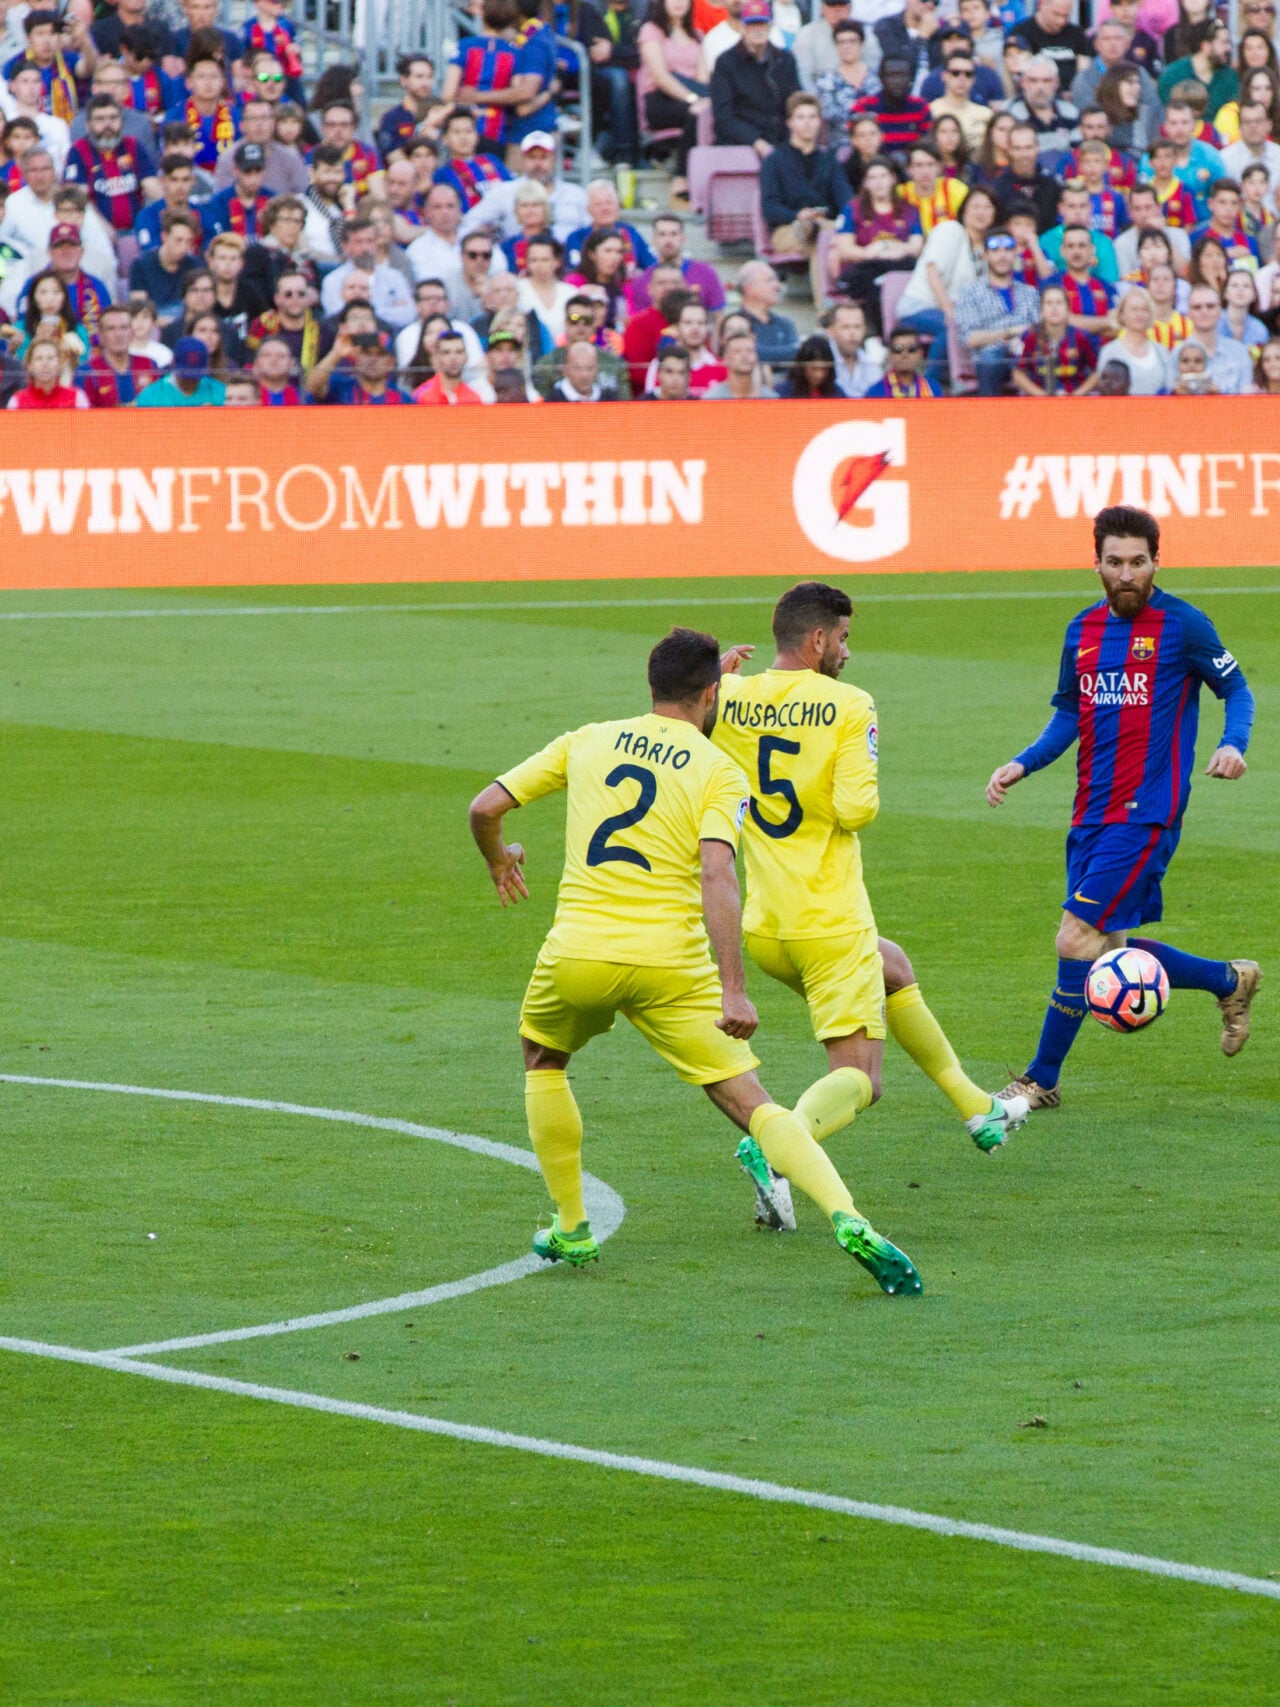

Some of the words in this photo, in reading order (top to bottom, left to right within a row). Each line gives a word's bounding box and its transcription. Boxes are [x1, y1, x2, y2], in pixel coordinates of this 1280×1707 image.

[0, 459, 706, 535] WINFROMWITHIN
[792, 418, 911, 562] G
[723, 699, 837, 727] MUSACCHIO
[1080, 672, 1148, 697] QATAR
[1089, 692, 1149, 705] AIRWAYS
[614, 731, 691, 770] MARIO
[749, 735, 804, 839] 5
[586, 763, 657, 873] 2
